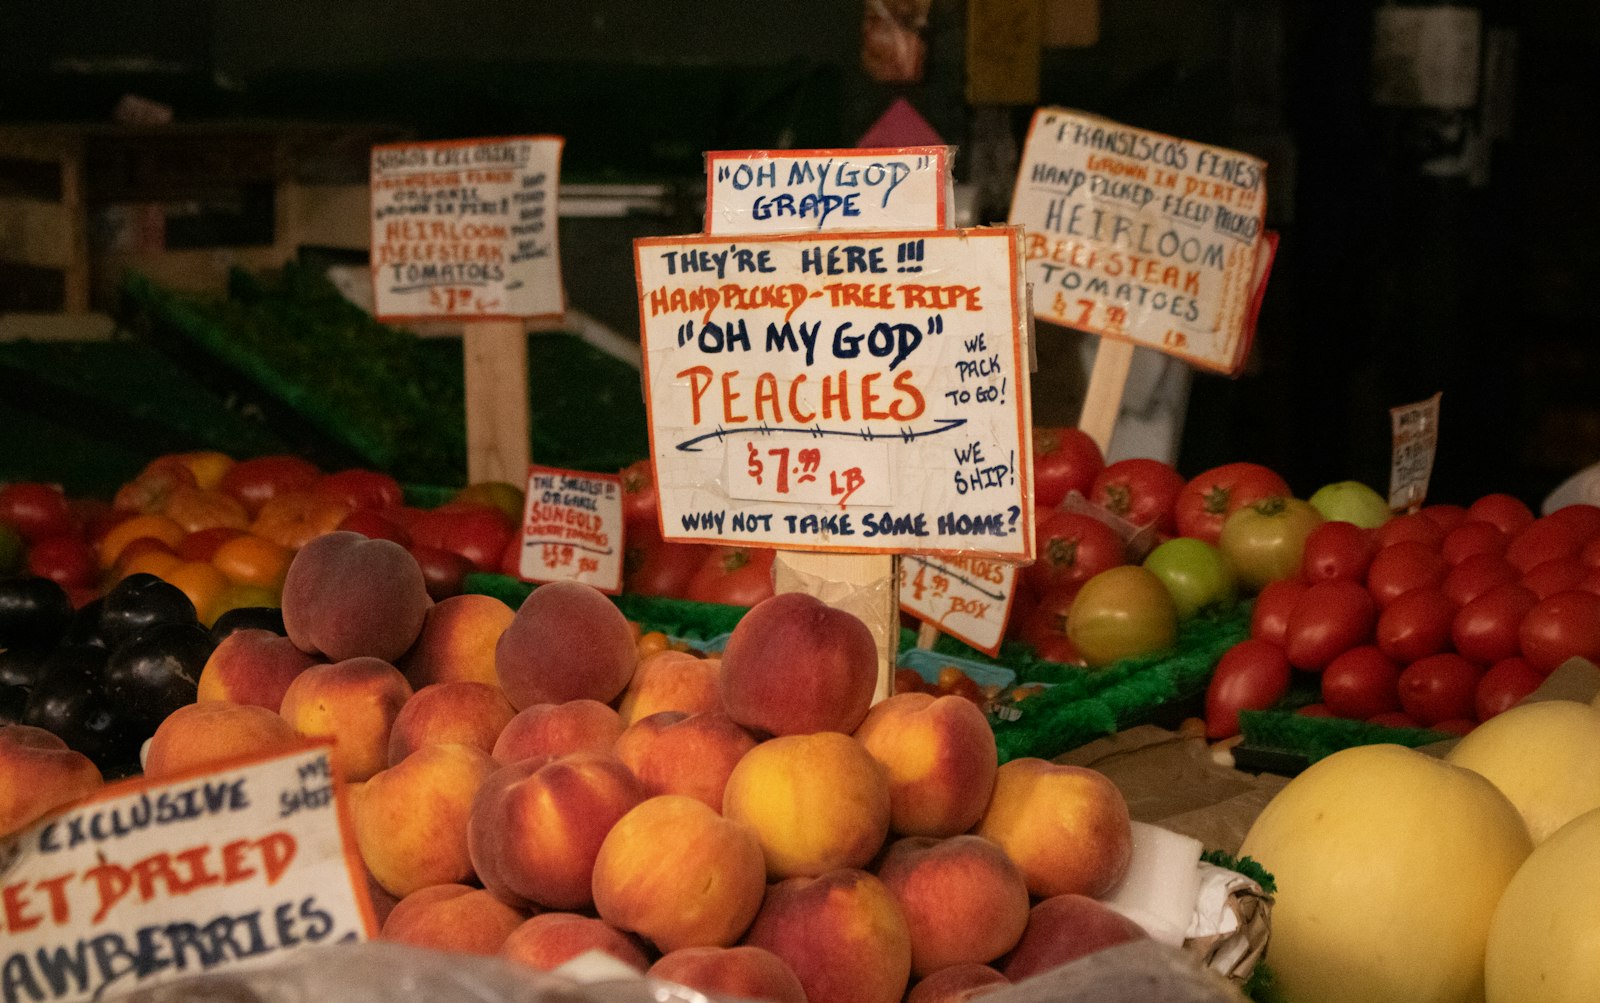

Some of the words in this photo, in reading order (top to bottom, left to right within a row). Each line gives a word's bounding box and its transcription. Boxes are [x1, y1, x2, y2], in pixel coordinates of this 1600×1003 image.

[788, 159, 833, 200] MY
[1031, 164, 1086, 196] HAND
[1088, 156, 1146, 181] GROWN
[1154, 169, 1178, 188] IN
[753, 193, 861, 230] GRADE
[387, 222, 506, 241] HEIRLOOM
[1046, 199, 1225, 271] HEIRLOOM
[393, 264, 504, 281] TOMATOES
[661, 244, 776, 278] THEY'RE
[1026, 232, 1200, 297] BEEFSTEAK
[1042, 263, 1199, 322] TOMATOES
[766, 321, 821, 366] MY
[964, 333, 988, 354] WE
[955, 356, 1001, 382] PACK
[676, 365, 926, 426] PEACHES
[946, 390, 971, 406] TO
[976, 376, 1006, 405] GO!
[954, 442, 985, 466] WE
[534, 477, 553, 489] THE
[830, 467, 866, 511] LB
[954, 450, 1014, 495] SHIP!
[682, 511, 726, 535] WHY
[732, 514, 773, 533] NOT
[784, 515, 855, 535] TAKE
[862, 514, 930, 537] SOME
[937, 506, 1021, 537] HOME?
[944, 596, 990, 621] BOX
[40, 777, 249, 853] EXCLUSIVE
[82, 832, 298, 926] DRIED
